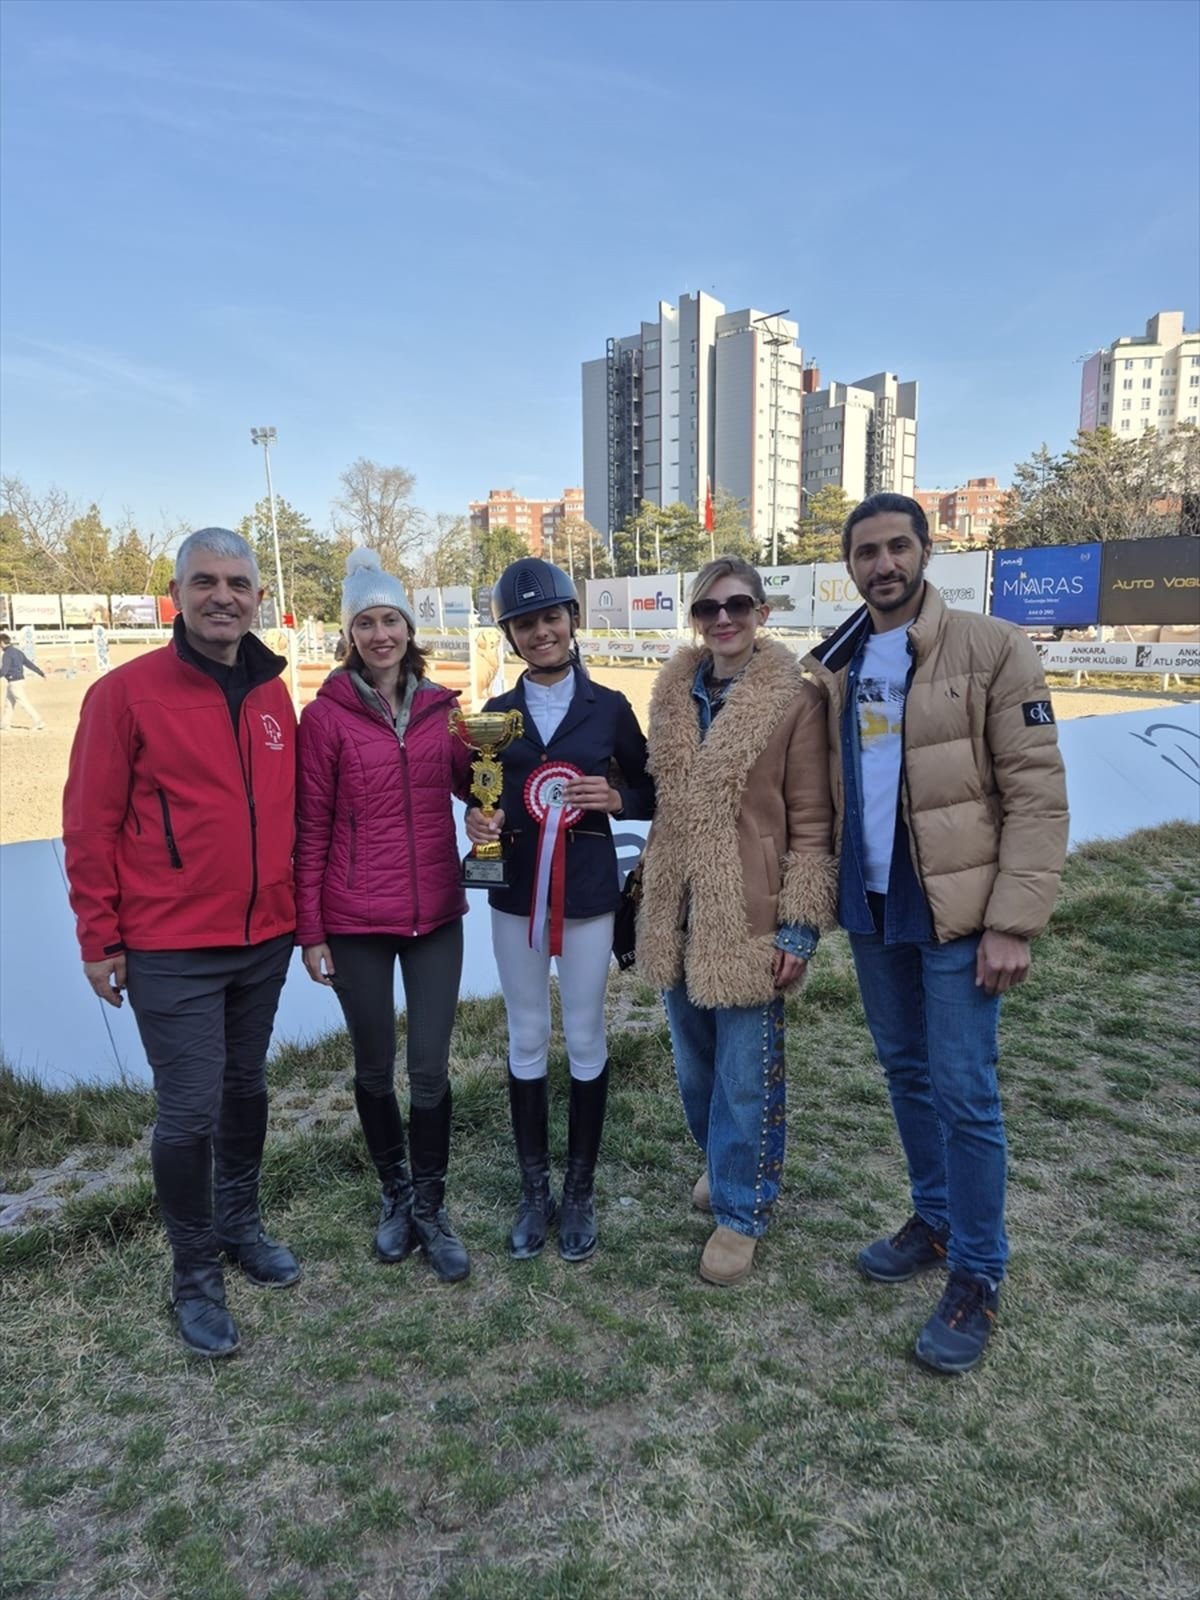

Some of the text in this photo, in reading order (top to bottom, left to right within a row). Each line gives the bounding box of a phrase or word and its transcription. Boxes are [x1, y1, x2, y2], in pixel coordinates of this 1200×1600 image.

[764, 576, 790, 587] KCP
[1112, 579, 1155, 590] AUTO
[1071, 647, 1106, 655] ANKARA
[1178, 648, 1200, 656] ANK
[1068, 656, 1091, 664] SPOR
[1093, 656, 1128, 665] KULÜBÜ
[1153, 658, 1173, 666] ATLI
